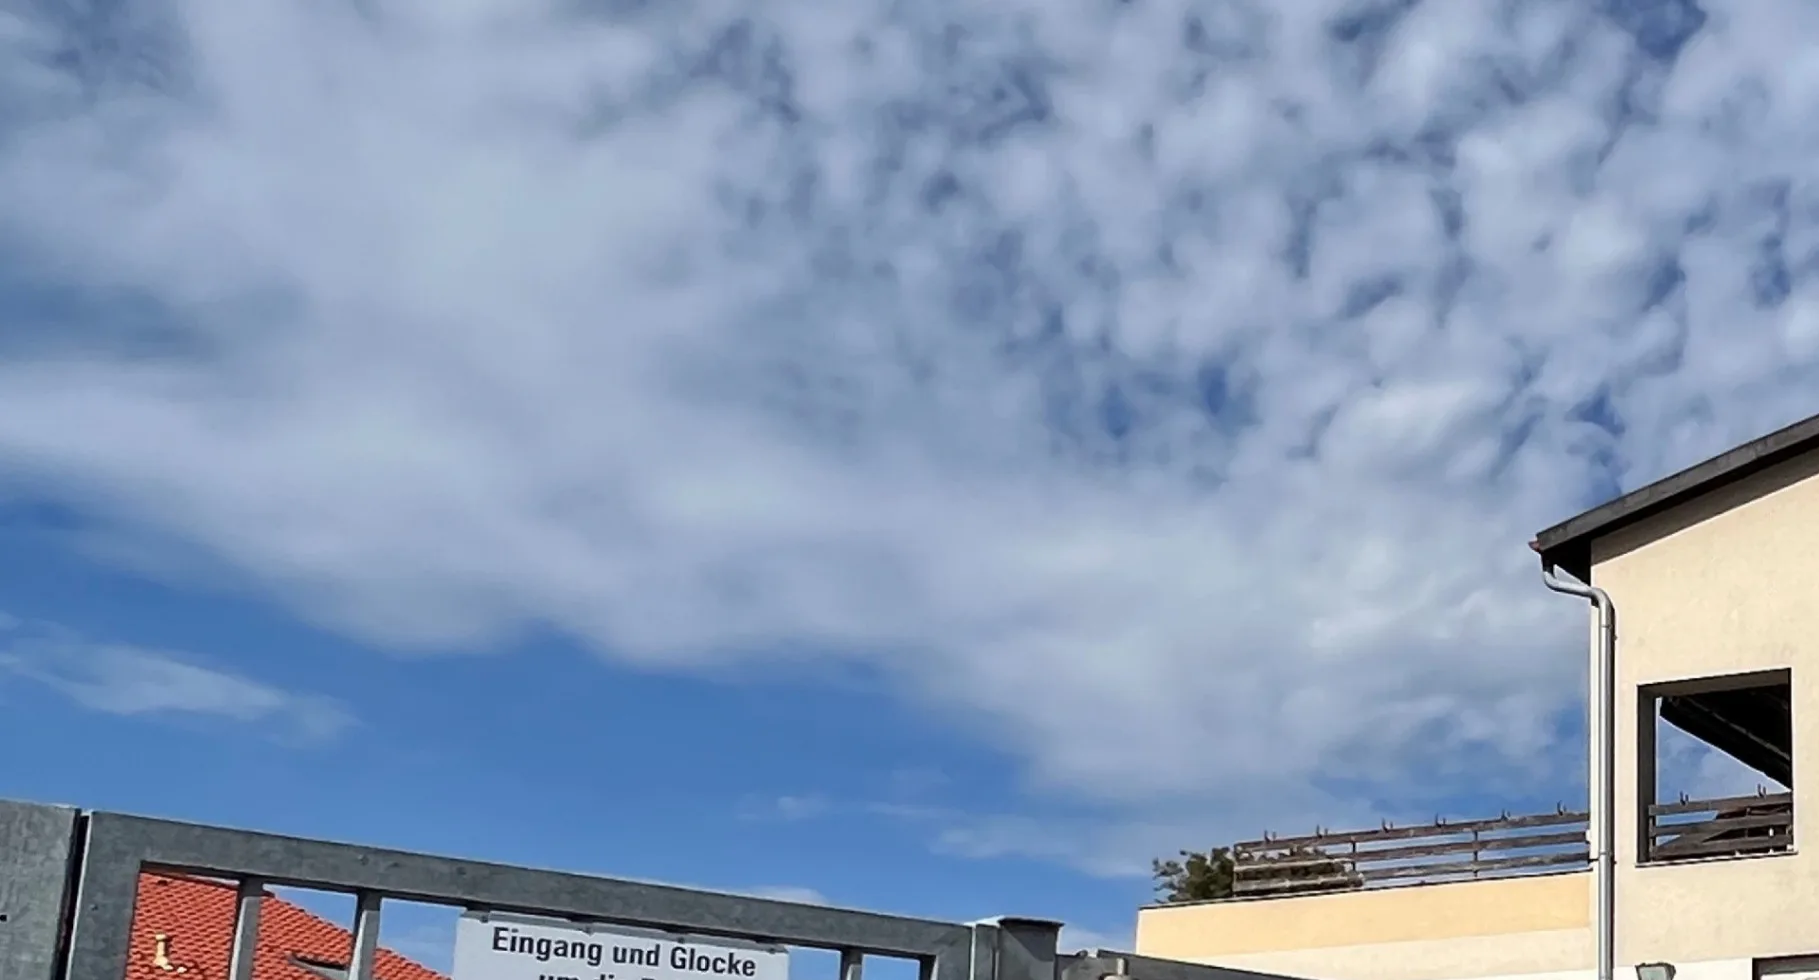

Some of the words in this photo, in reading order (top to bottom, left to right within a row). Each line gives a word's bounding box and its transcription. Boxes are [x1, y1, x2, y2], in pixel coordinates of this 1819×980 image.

[492, 926, 603, 966] Eingang
[612, 944, 661, 967] und
[670, 946, 757, 977] Glocke
